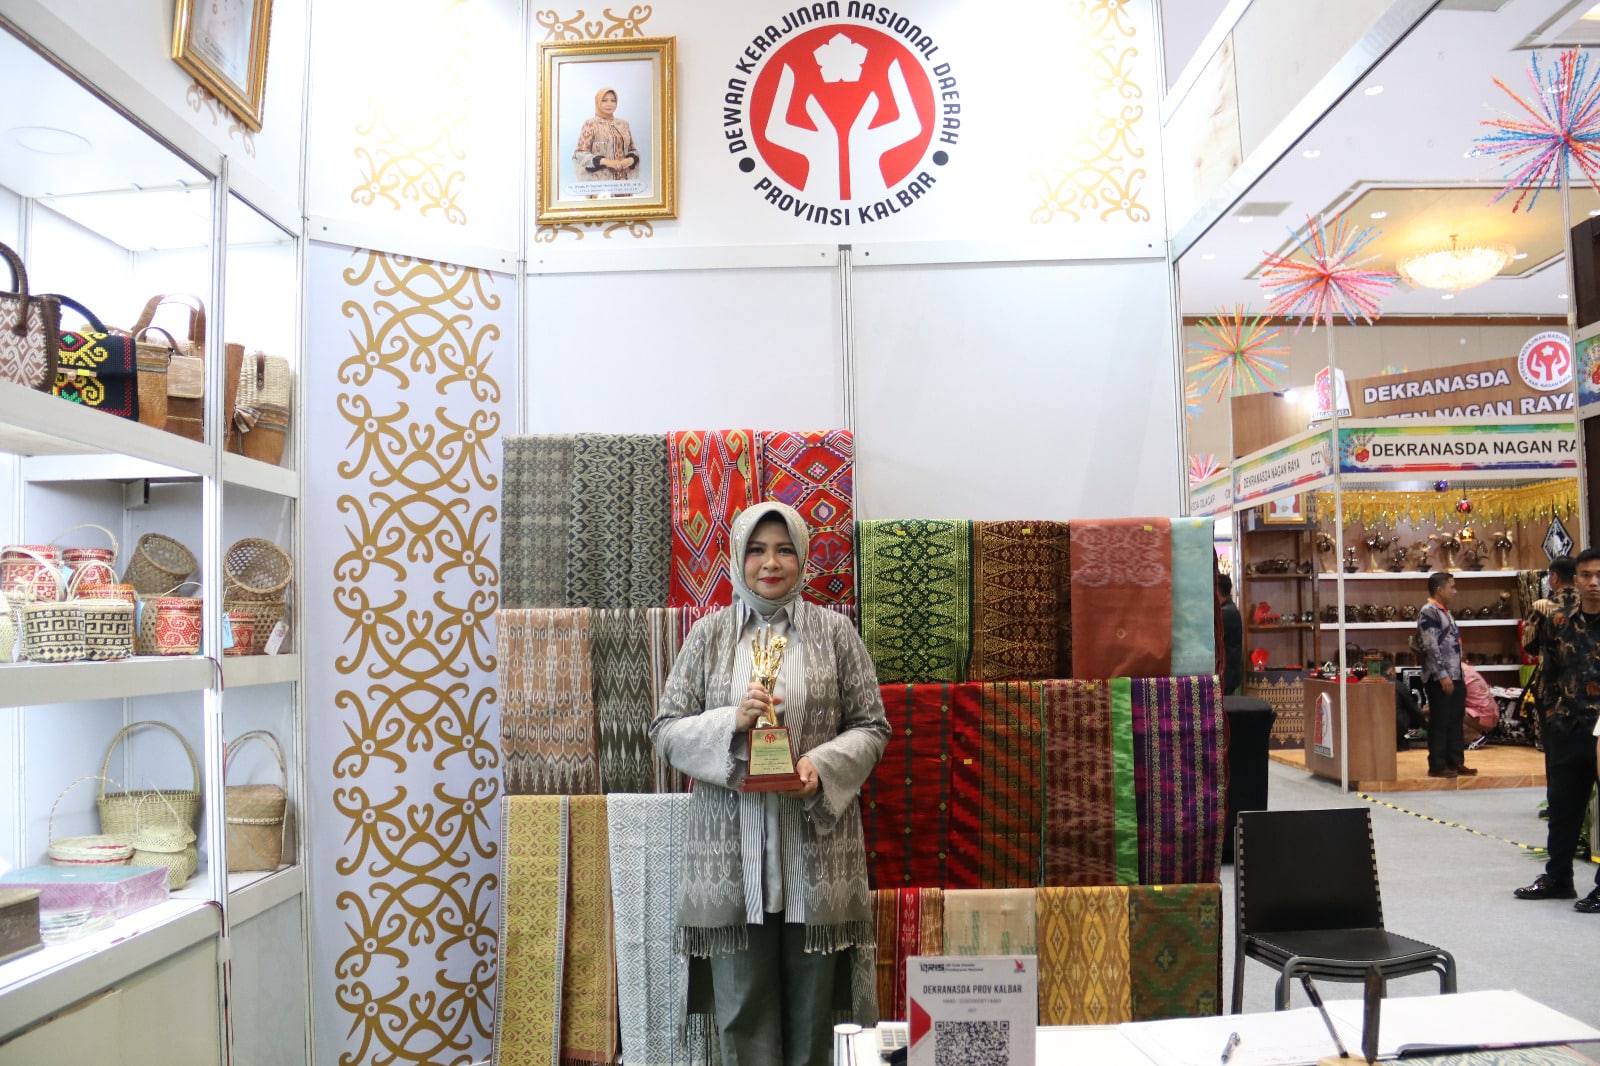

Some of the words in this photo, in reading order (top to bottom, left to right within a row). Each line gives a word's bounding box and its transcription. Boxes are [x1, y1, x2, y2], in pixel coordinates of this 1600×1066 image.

[735, 0, 840, 75] KERAJINAN
[847, 0, 940, 61] NASIONAL
[723, 78, 748, 154] DEWAN
[932, 62, 961, 145] DAERAH
[753, 176, 850, 226] PROVINSI
[858, 171, 937, 225] KALBAR
[1364, 369, 1511, 404] DEKRANASDA
[1372, 441, 1489, 457] DEKRANASDA
[1493, 440, 1552, 455] NAGAN
[922, 984, 971, 995] DEKRANASDA
[972, 984, 992, 994] PROV
[993, 984, 1023, 994] KALBAR
